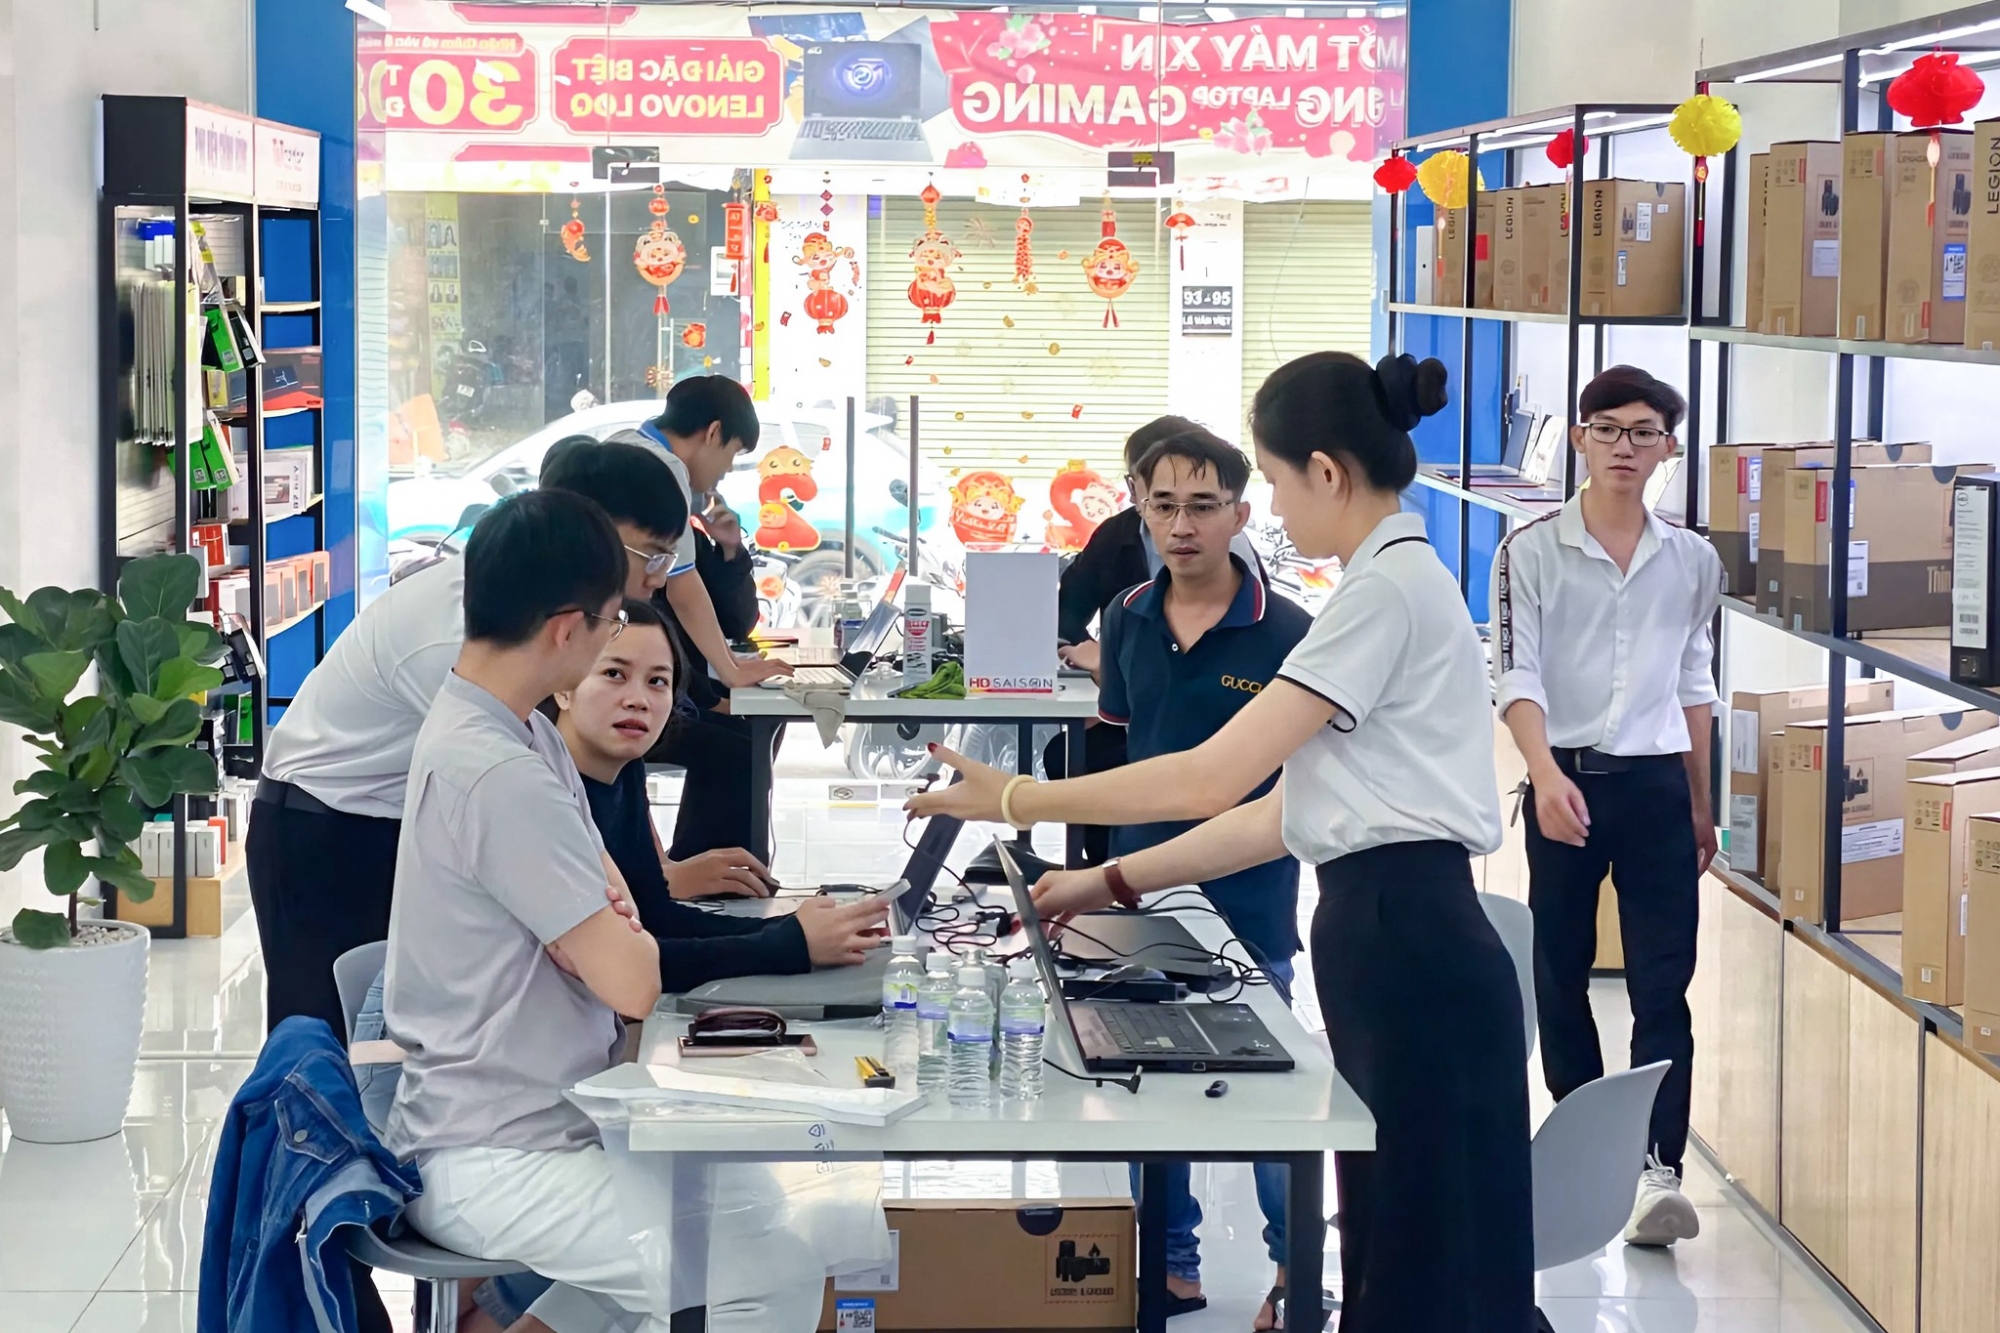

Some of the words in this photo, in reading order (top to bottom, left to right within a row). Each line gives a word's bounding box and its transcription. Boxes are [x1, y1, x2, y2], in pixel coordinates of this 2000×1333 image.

[1987, 137, 2000, 214] LEGION
[1505, 196, 1514, 240] LEGION
[1593, 189, 1603, 237] LEGION
[969, 677, 991, 688] HD
[1221, 675, 1263, 694] GUCCI
